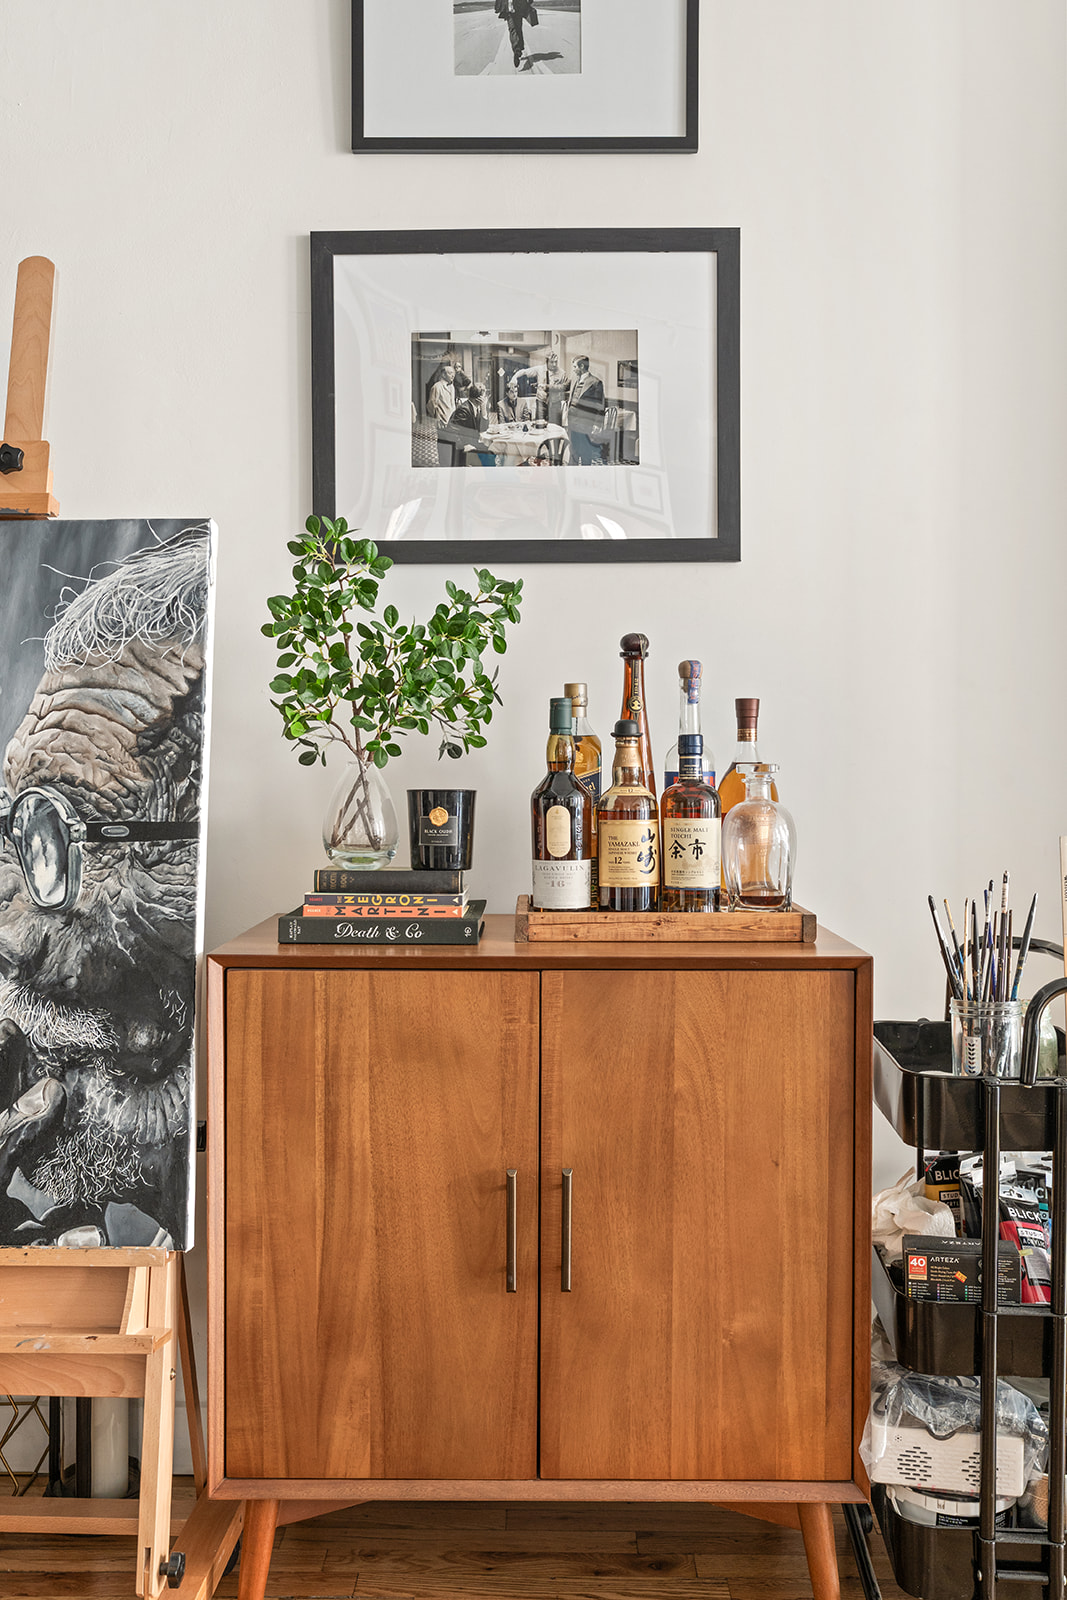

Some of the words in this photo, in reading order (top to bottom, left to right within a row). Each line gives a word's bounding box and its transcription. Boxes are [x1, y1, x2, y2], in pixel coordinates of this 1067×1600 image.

[668, 838, 706, 860] 余市
[344, 894, 438, 906] NEGRONI
[334, 906, 446, 916] MARTINI
[334, 922, 380, 938] Death
[385, 926, 400, 940] &
[405, 922, 424, 939] Co
[934, 1169, 960, 1181] BLIC
[1008, 1206, 1042, 1223] BLICK
[910, 1258, 926, 1267] 40
